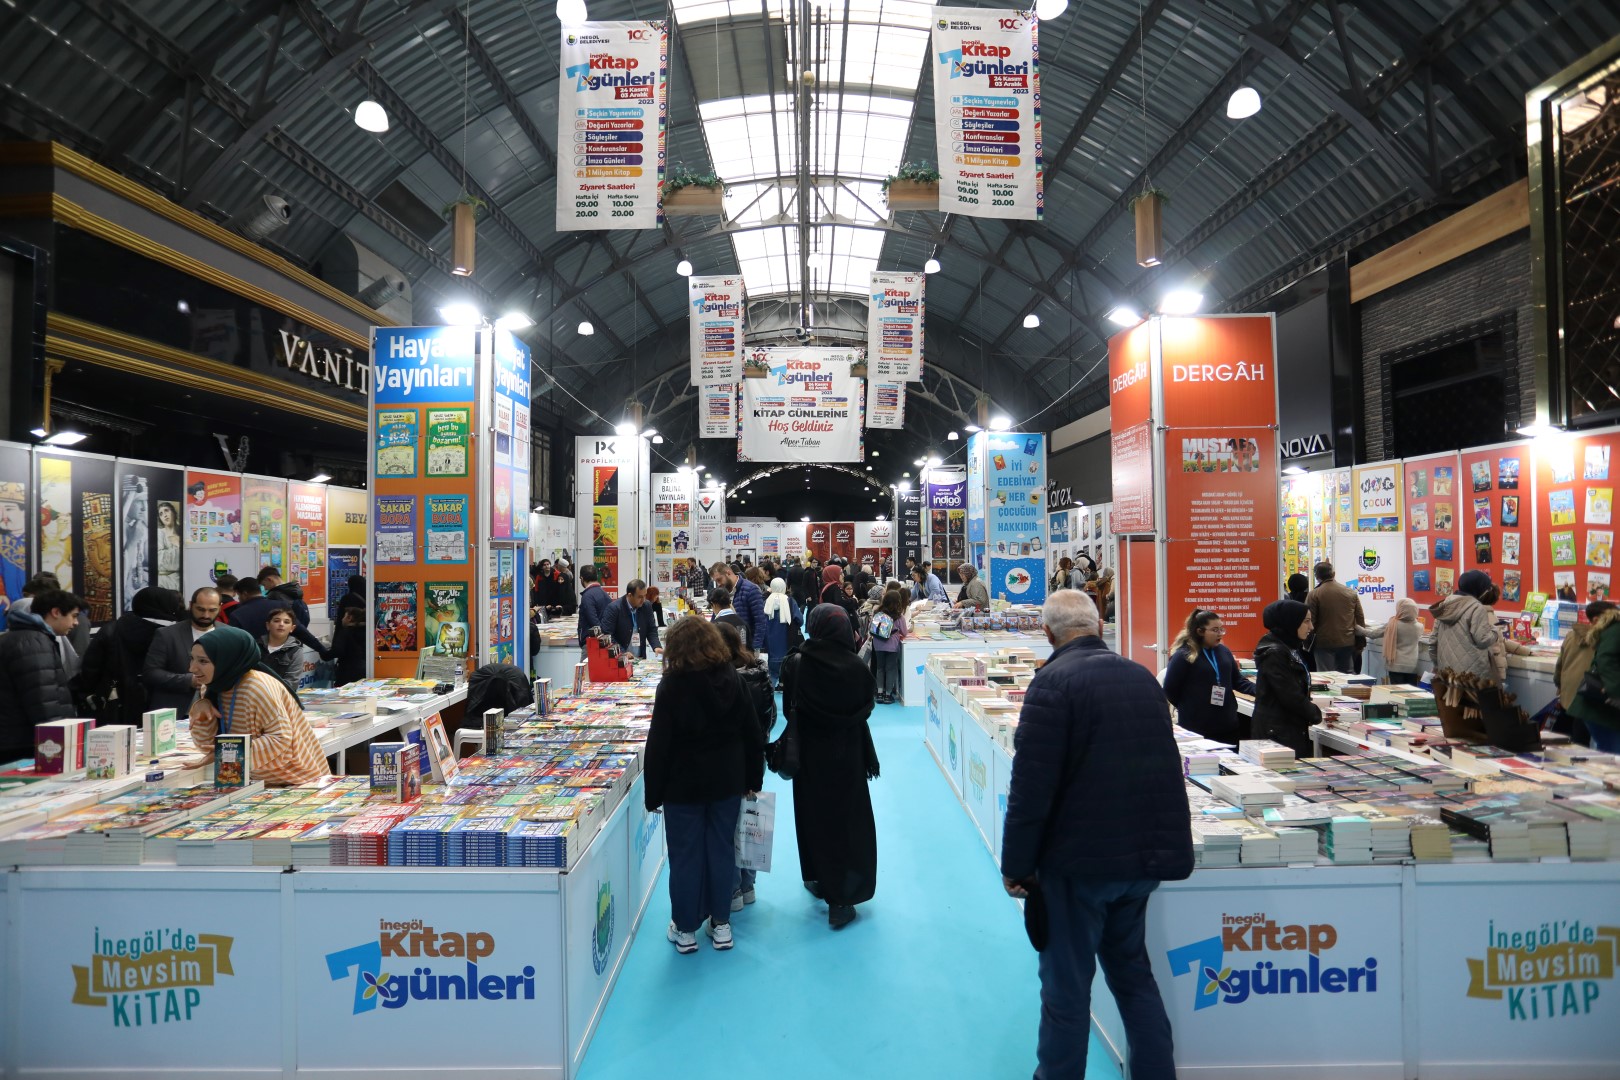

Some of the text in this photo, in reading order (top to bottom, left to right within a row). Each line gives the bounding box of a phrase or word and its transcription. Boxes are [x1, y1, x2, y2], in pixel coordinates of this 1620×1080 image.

[963, 58, 1028, 77] günleri
[590, 70, 654, 91] günleri
[964, 97, 1016, 106] Seçkin Yayınevleri
[588, 109, 641, 118] Seçkin Yayınevleri
[588, 121, 609, 129] Değerli
[964, 121, 994, 130] Söyleşiler
[587, 134, 618, 142] Söyleşiler
[965, 133, 1004, 141] Konferanslar
[966, 144, 980, 152] İmza
[588, 156, 602, 164] İmza
[991, 158, 1009, 166] Kitap
[592, 169, 609, 177] Milyon
[610, 169, 630, 177] Kitap
[959, 171, 985, 179] Ziyaret
[958, 186, 979, 196] 09.00
[958, 196, 979, 204] 20.00
[576, 210, 598, 218] 20.00
[705, 302, 739, 312] günleri
[885, 298, 918, 308] günleri
[390, 335, 448, 365] Haya
[787, 360, 821, 371] Kitap
[1173, 361, 1264, 382] DERGÂH
[787, 371, 832, 385] günleri
[1112, 361, 1147, 394] DERGÂH
[754, 408, 848, 418] KİTAP GÜNLERİNE
[768, 420, 833, 434] Hoş Geldiniz
[780, 437, 800, 446] Alper
[1182, 438, 1257, 453] MUSTAFA
[1011, 460, 1022, 472] İYİ
[998, 475, 1037, 486] EDEBİYAT
[933, 495, 961, 507] indigo
[1008, 492, 1025, 502] HER
[380, 503, 412, 513] SAKAR
[431, 503, 463, 513] SAKAR
[1363, 498, 1392, 509] ÇOCUK
[998, 506, 1037, 518] ÇOCUĞUN
[380, 513, 411, 525] BORA
[432, 513, 463, 524] BORA
[998, 522, 1037, 532] HAKKIDIR
[1358, 584, 1394, 594] günleri
[1222, 912, 1265, 927] inegöl
[380, 918, 423, 933] inegöl
[1488, 919, 1594, 953] İnegöl'de
[94, 926, 197, 960] İnegöl'de
[1497, 947, 1600, 982] Mevsim
[102, 955, 201, 989] Mevsim
[1166, 935, 1224, 1012] 7
[325, 941, 383, 1016] 7
[1223, 953, 1378, 1004] günleri
[381, 960, 536, 1009] günleri
